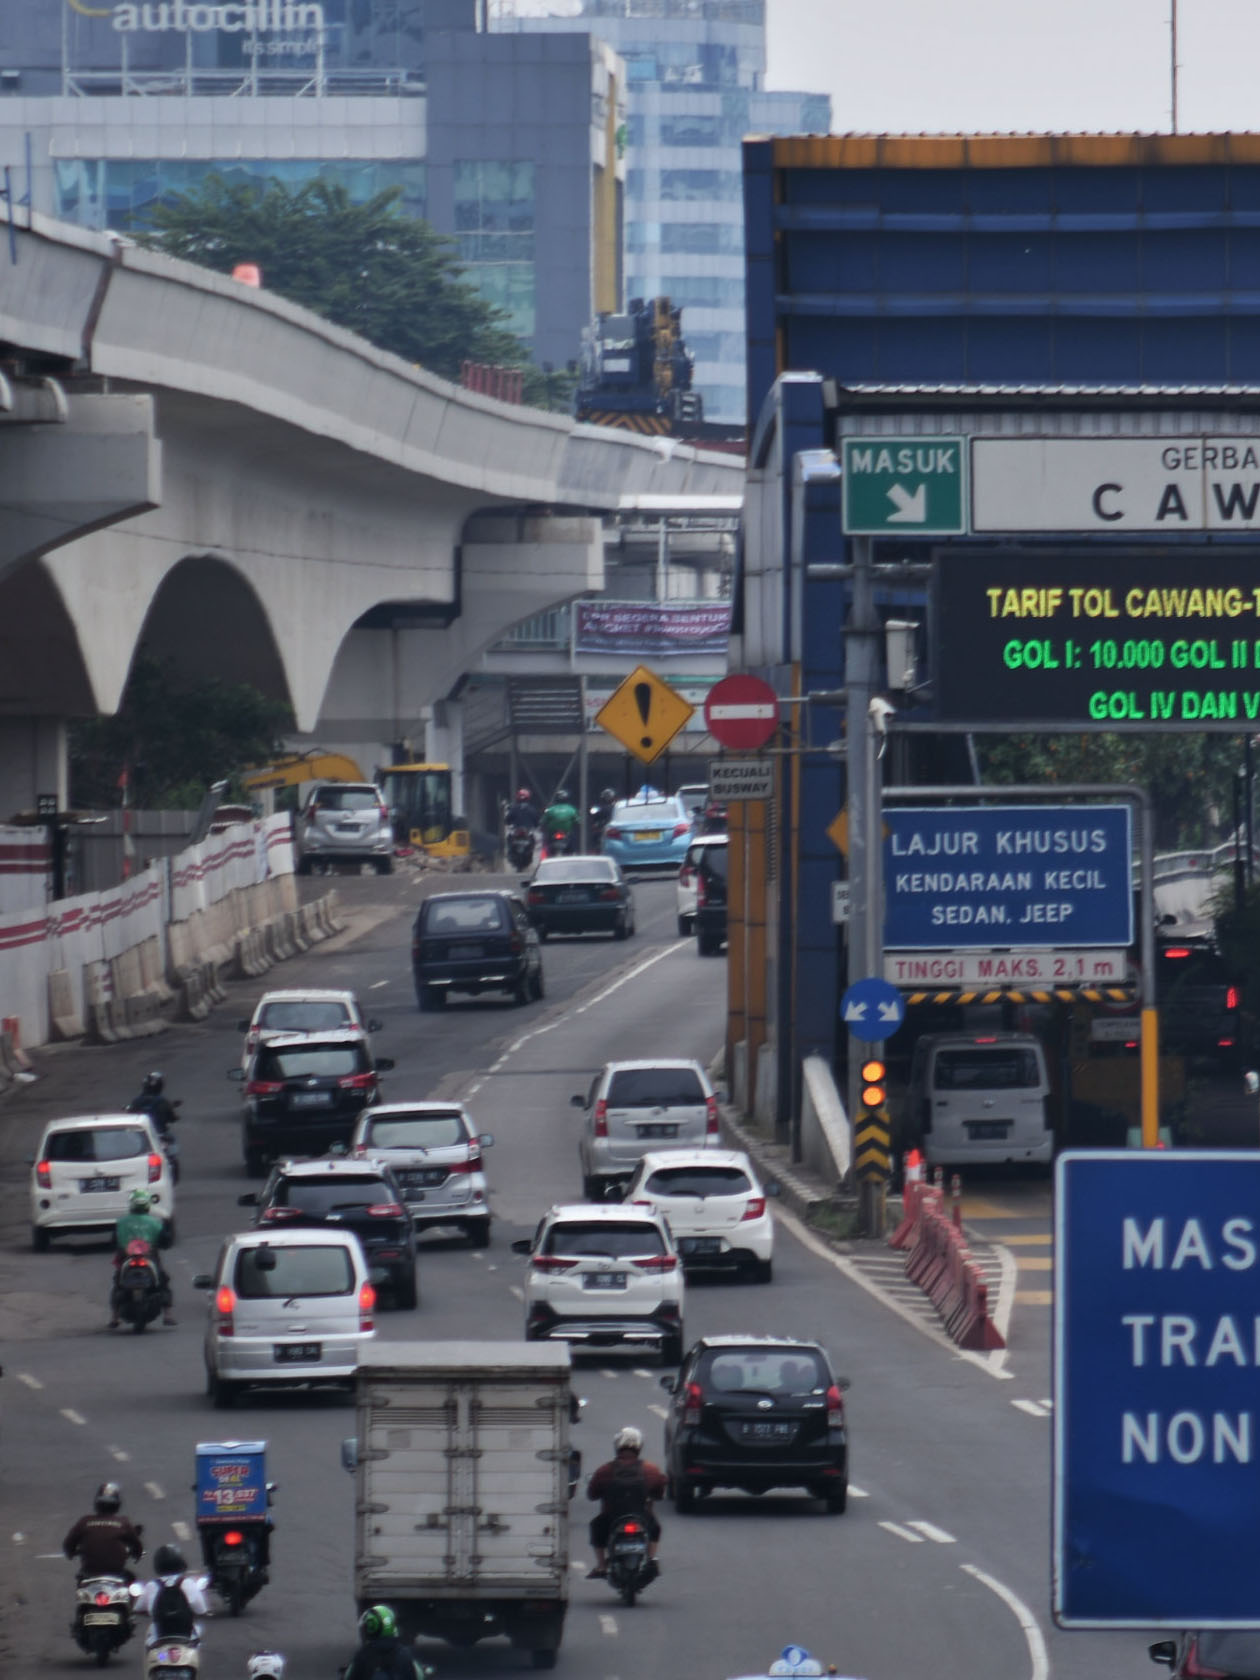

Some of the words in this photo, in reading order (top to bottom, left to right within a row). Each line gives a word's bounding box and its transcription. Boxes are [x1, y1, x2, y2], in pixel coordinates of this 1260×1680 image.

[112, 0, 323, 32] autocillin
[851, 447, 954, 474] MASUK
[986, 587, 1062, 618] TARIF
[1069, 588, 1119, 618] TOL
[1003, 640, 1059, 669] GOL
[1089, 640, 1164, 669] 10.000
[1170, 640, 1224, 669] GOL
[1232, 640, 1247, 669] II
[1089, 691, 1143, 719] GOL
[1150, 691, 1176, 719] IV
[1181, 691, 1237, 719] DAN
[713, 767, 770, 779] KECUALI
[713, 782, 768, 795] BUSWAY
[891, 831, 978, 856] LAJUR
[996, 830, 1107, 855] KHUSUS
[896, 872, 1031, 893] KENDARAAN
[1045, 870, 1106, 890] KECIL
[1019, 903, 1073, 924] JEEP
[895, 960, 963, 980] TINGGI
[978, 959, 1043, 979] MAKS.
[1094, 960, 1113, 976] m
[1121, 1412, 1251, 1464] NON
